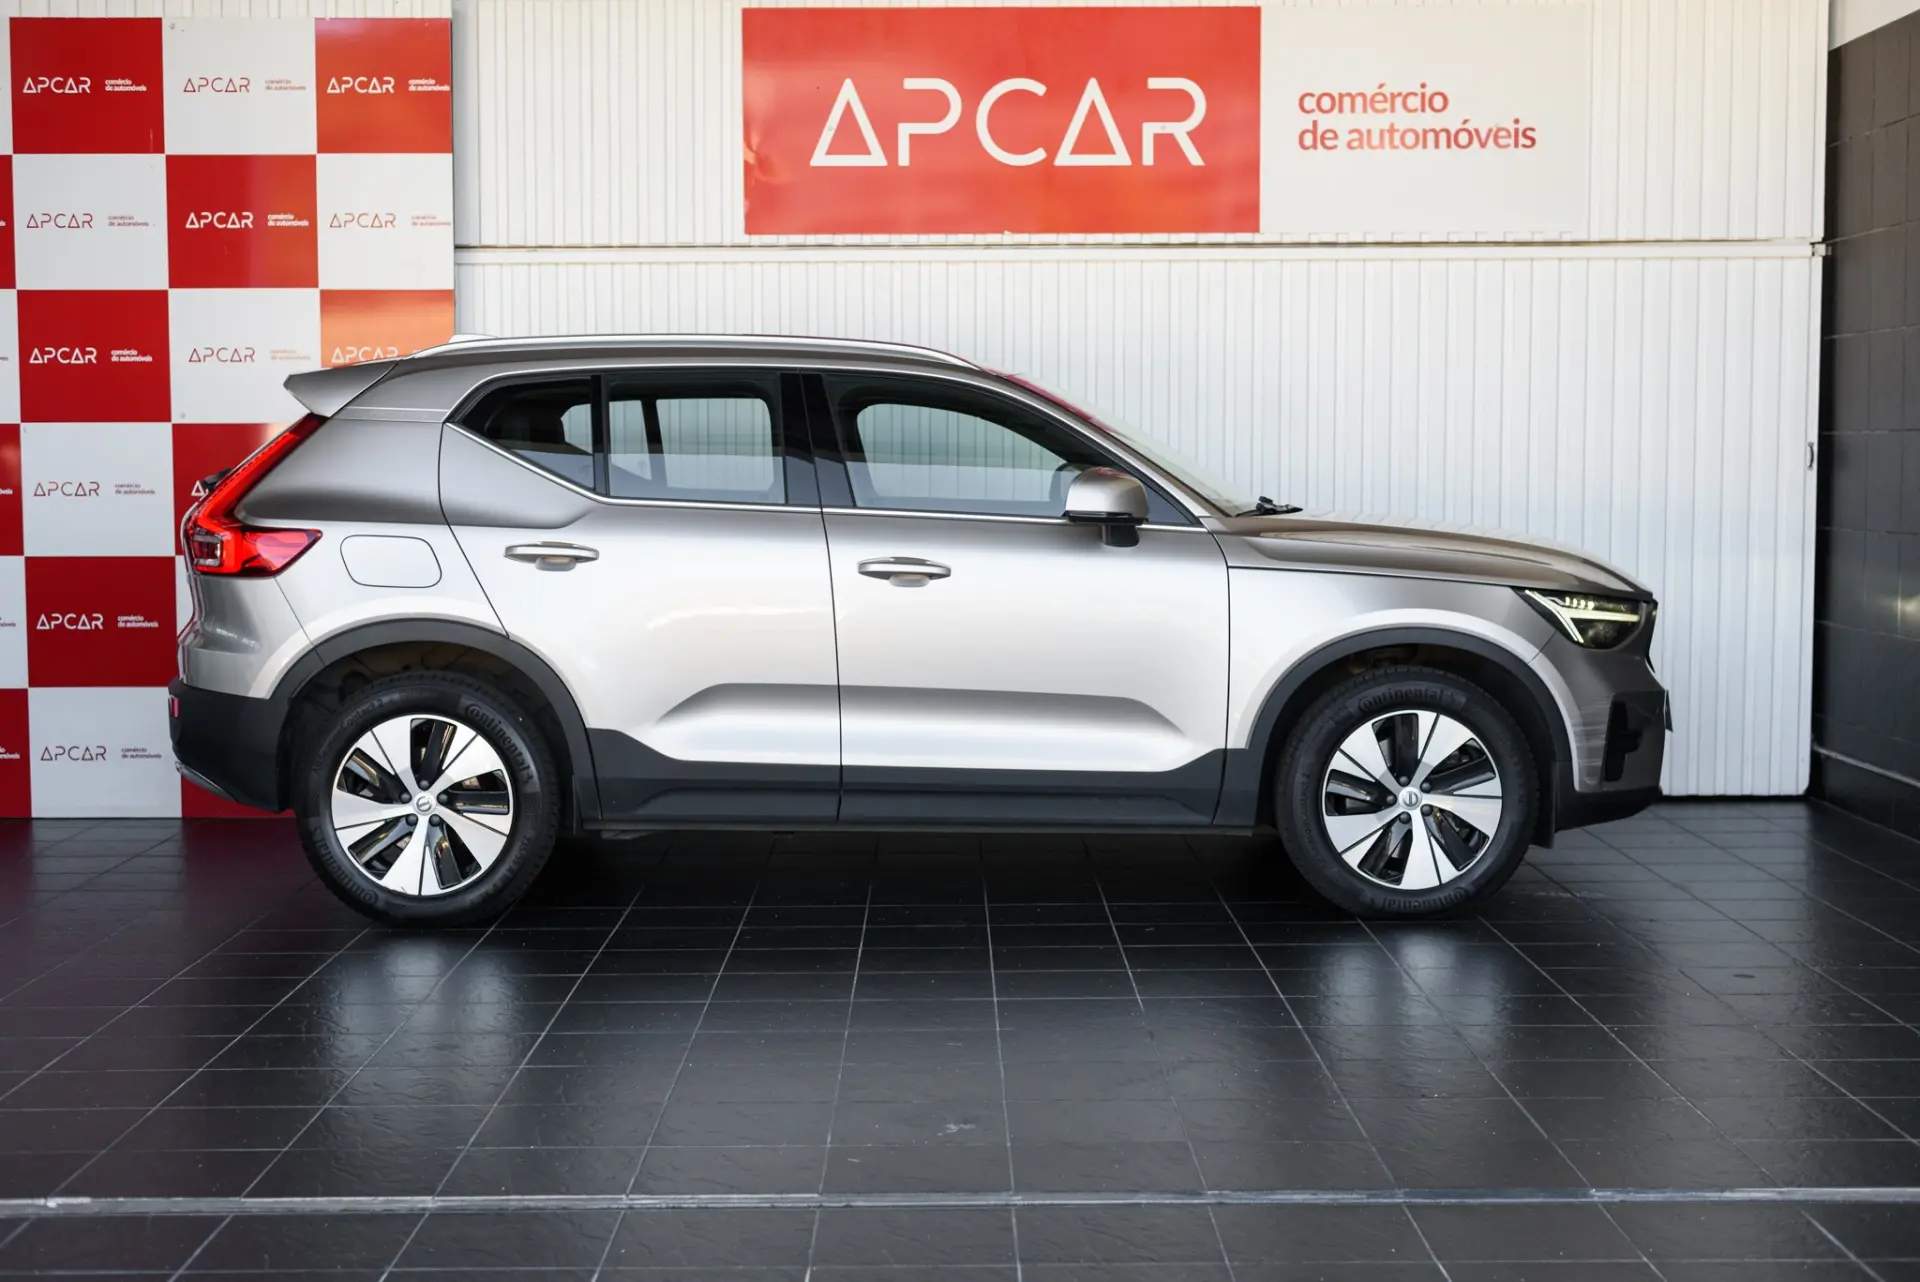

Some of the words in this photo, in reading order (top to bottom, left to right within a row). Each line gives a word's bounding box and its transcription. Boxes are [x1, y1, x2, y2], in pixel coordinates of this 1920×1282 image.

[23, 77, 91, 93] APCAR
[183, 77, 250, 92] APCAR
[327, 77, 395, 94] APCAR
[1298, 82, 1449, 114] comércio
[810, 78, 1206, 167] APCAR
[1299, 119, 1338, 150] de
[1347, 118, 1536, 150] automóveis
[27, 213, 93, 228] APCAR
[185, 211, 254, 228] APCAR
[268, 212, 294, 220] comércio
[276, 218, 309, 226] automóveis
[329, 213, 396, 228] APCAR
[29, 347, 97, 364] APCAR
[188, 347, 255, 362] APCAR
[331, 346, 399, 363] APCAR
[34, 481, 100, 496] APCAR
[36, 613, 103, 630] APCAR
[465, 704, 532, 772] Continental
[41, 746, 107, 761] APCAR
